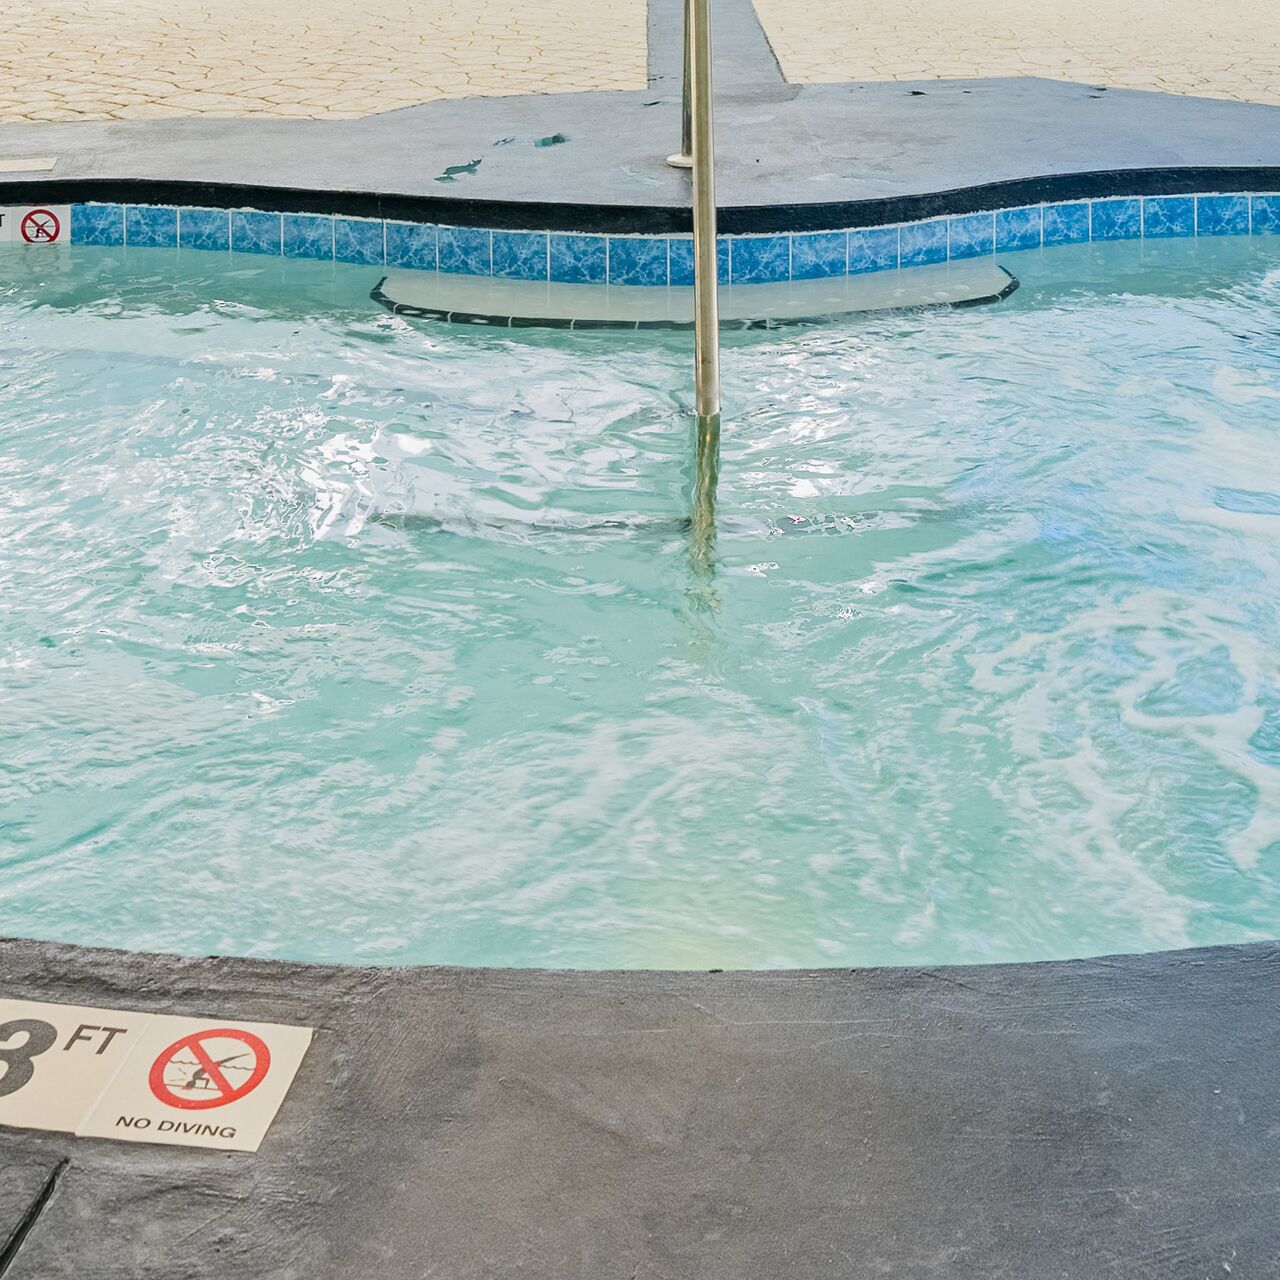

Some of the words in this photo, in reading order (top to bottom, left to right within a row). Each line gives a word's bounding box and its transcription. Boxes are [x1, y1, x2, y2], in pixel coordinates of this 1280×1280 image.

[63, 1024, 128, 1055] FT
[115, 1116, 151, 1129] NO
[157, 1120, 237, 1138] DIVING
